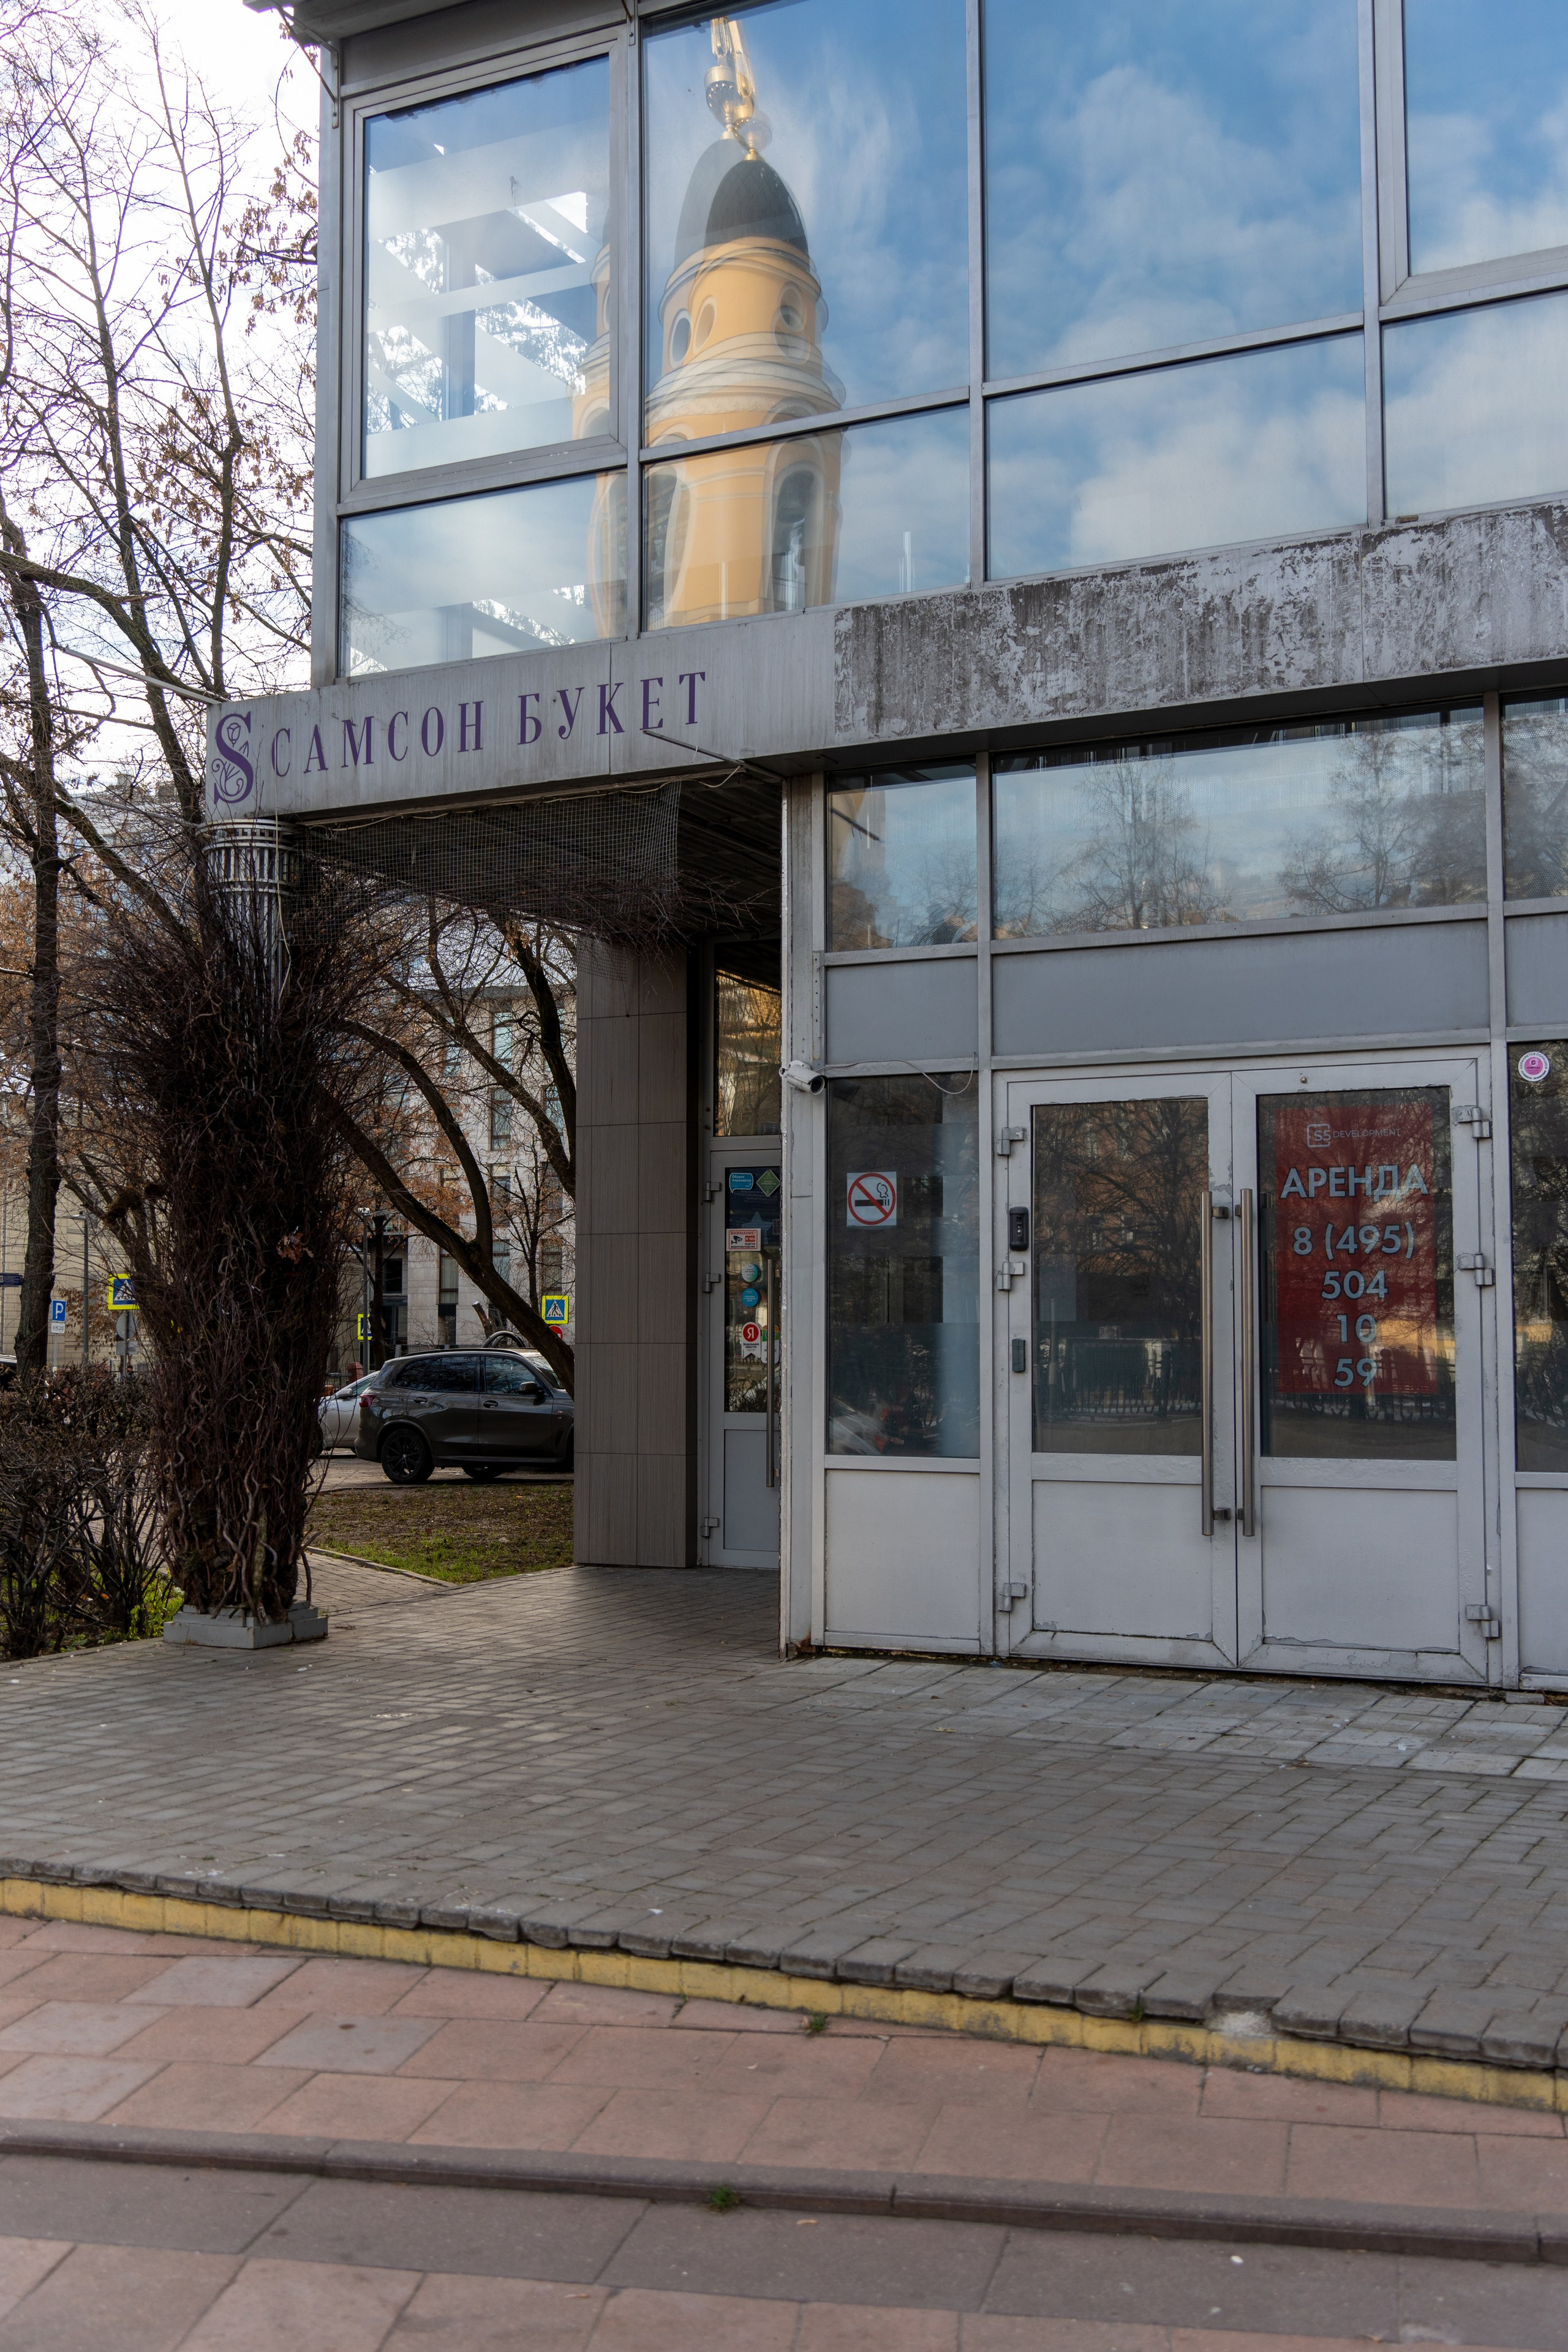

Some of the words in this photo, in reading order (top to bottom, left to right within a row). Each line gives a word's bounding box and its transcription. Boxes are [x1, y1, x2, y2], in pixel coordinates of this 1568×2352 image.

[271, 701, 483, 777] САМСОН
[518, 671, 706, 745] БУКЕТ
[1333, 1128, 1401, 1139] DEVELOPMENT
[1280, 1163, 1429, 1202] АРЕНДА
[1293, 1227, 1313, 1255] 8
[1325, 1222, 1414, 1261] (495)
[1321, 1270, 1389, 1300] 504
[747, 1327, 754, 1339] Я
[1337, 1314, 1377, 1343] 10
[1334, 1358, 1378, 1387] 59
